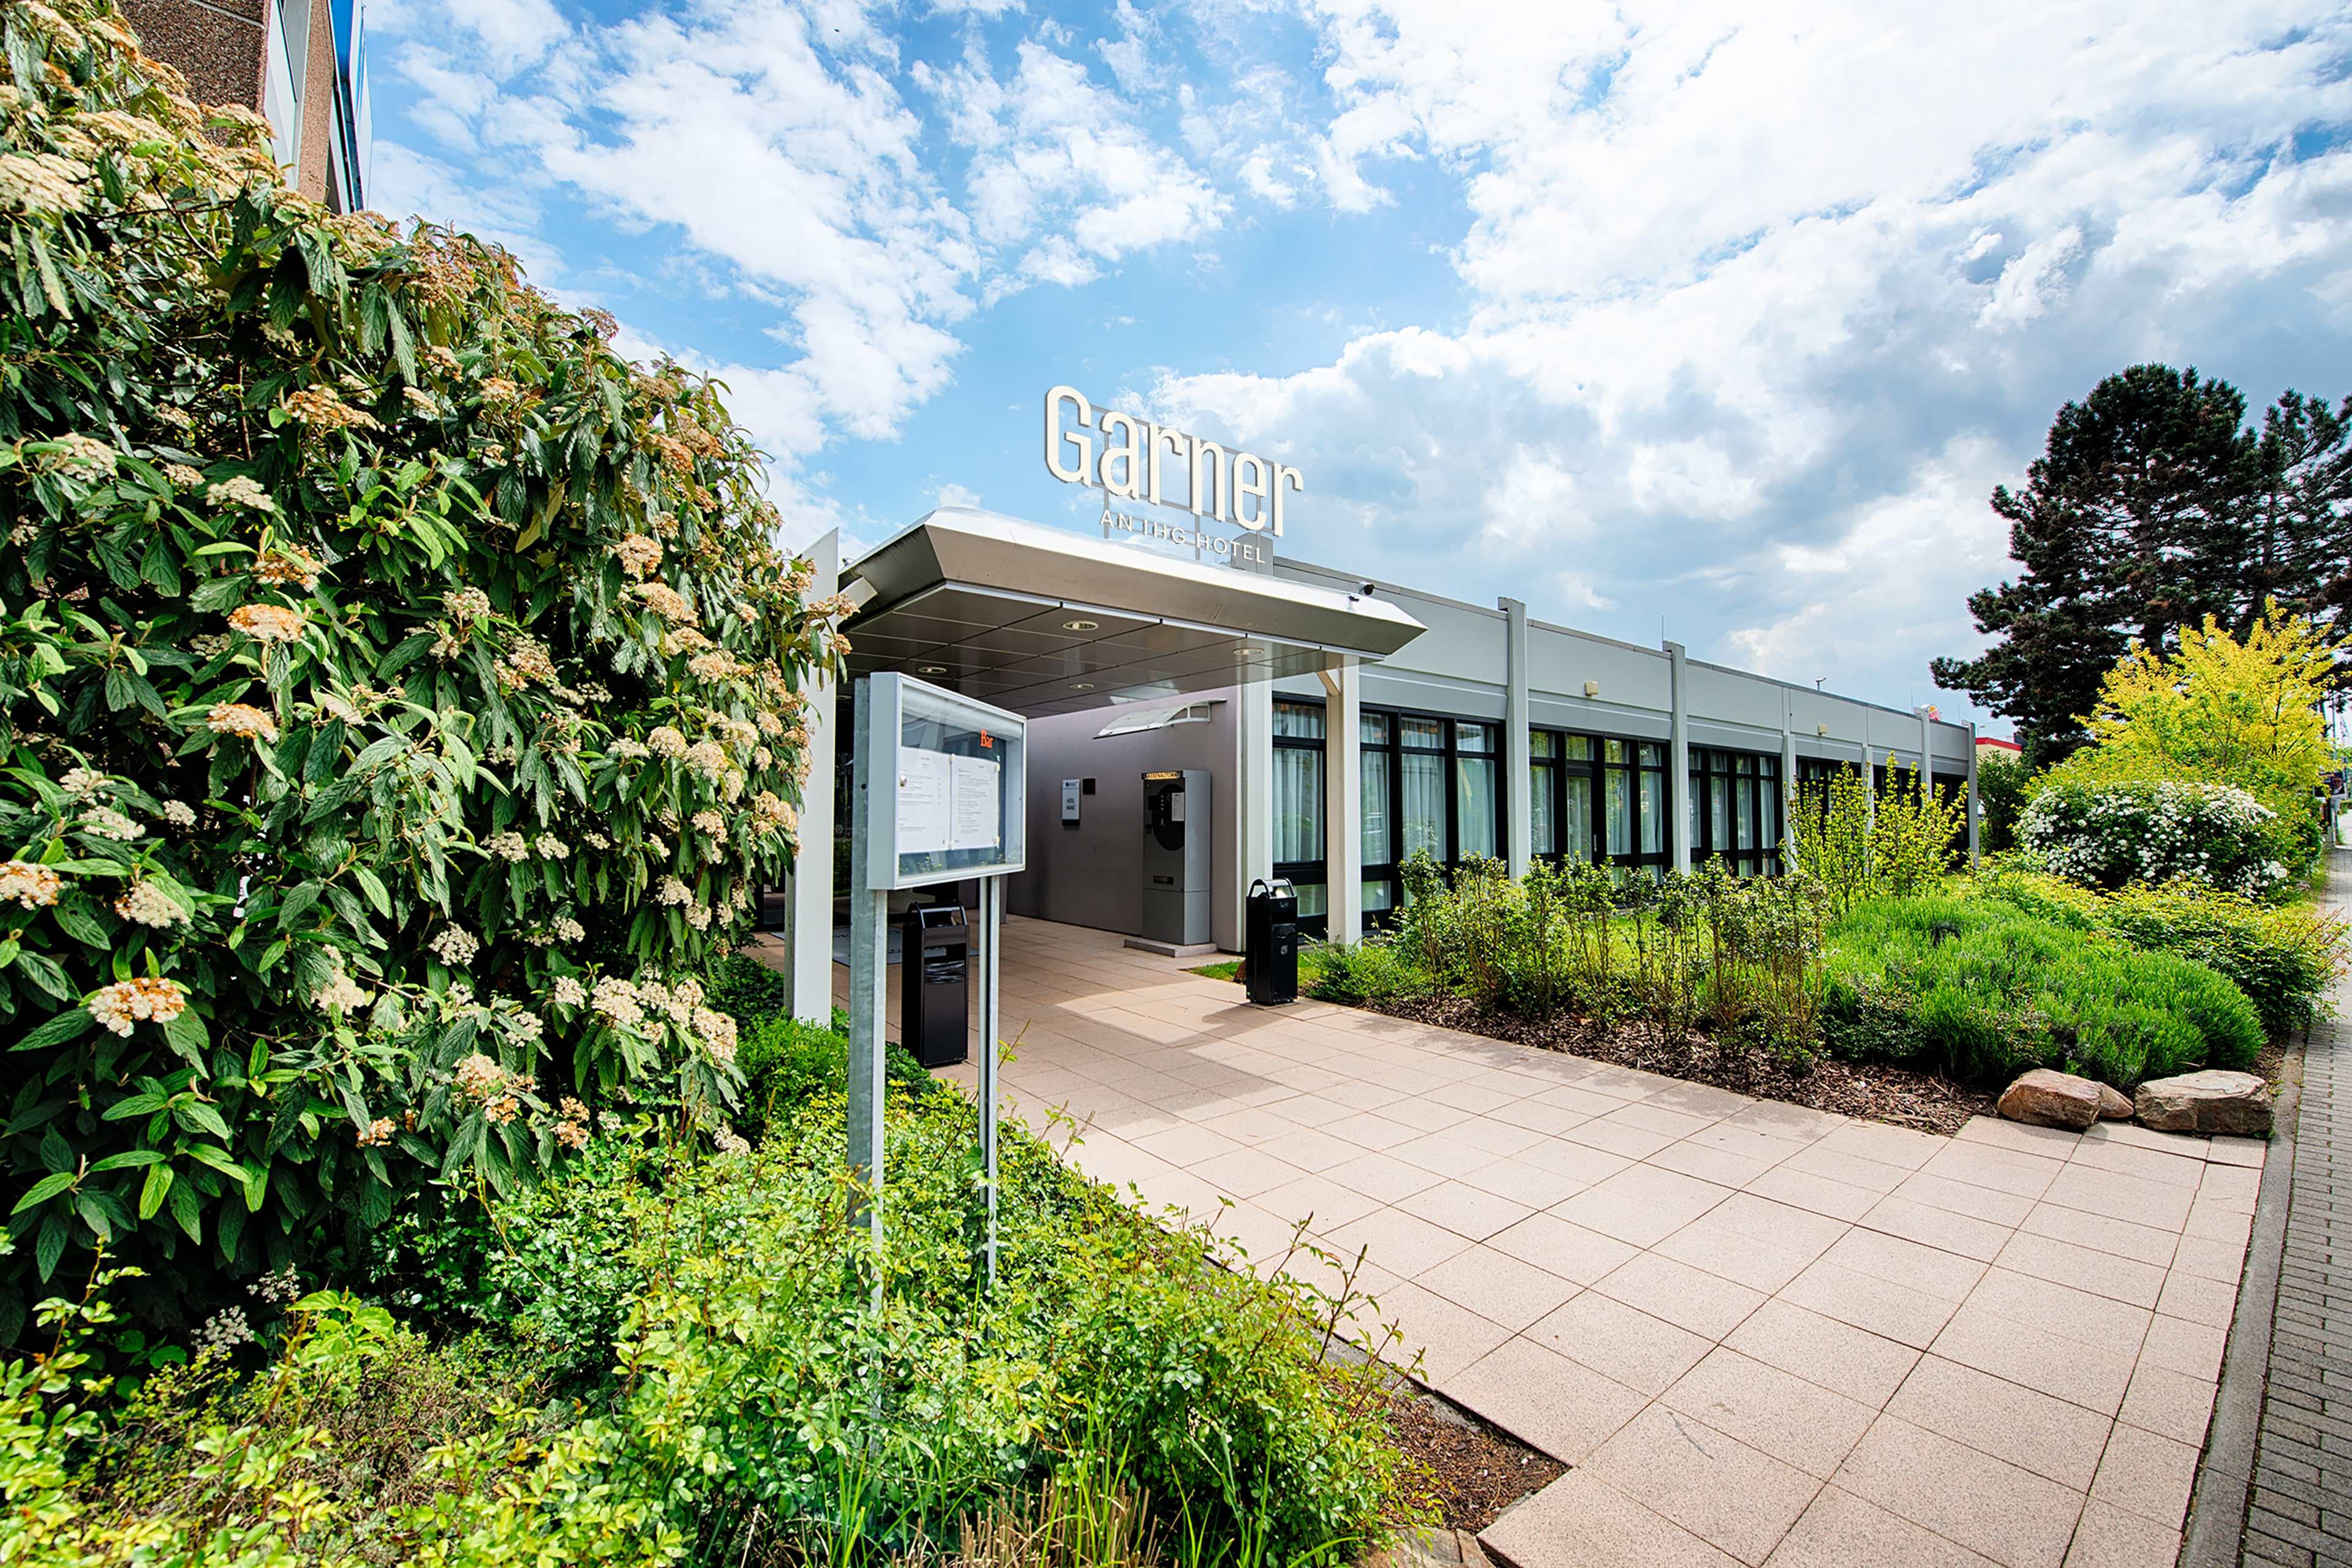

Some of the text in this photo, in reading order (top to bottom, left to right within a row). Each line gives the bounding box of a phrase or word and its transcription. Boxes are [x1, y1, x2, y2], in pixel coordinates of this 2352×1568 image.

[1045, 385, 1304, 537] Garner
[1099, 510, 1265, 564] AN IHG HOTEL
[981, 729, 993, 748] Bar
